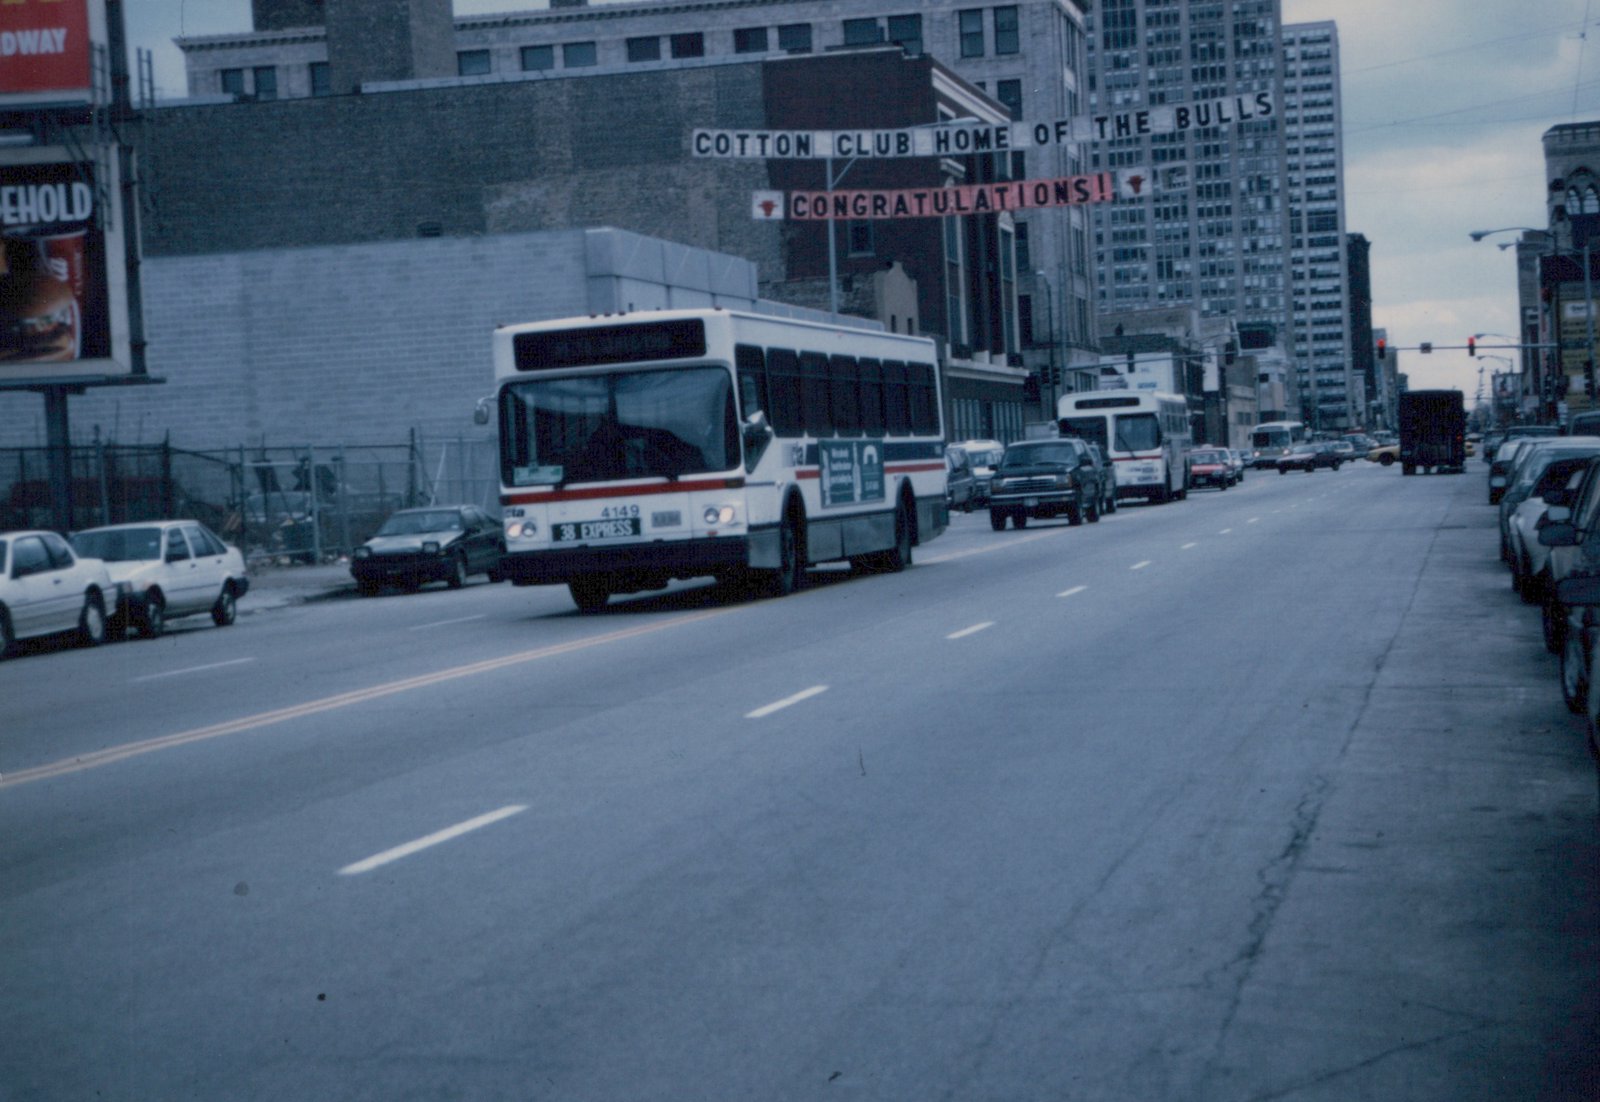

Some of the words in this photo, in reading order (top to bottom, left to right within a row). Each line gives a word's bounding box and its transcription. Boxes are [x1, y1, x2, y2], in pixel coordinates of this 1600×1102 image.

[0, 28, 67, 56] DWAY
[695, 132, 811, 155] COTTON
[837, 134, 909, 155] CLUB
[936, 127, 1008, 150] HOME
[1034, 120, 1068, 145] OF
[1095, 111, 1149, 139] THE
[1176, 92, 1272, 129] BULLS
[0, 182, 93, 223] EHOLD
[793, 173, 1105, 217] CONGRATULATIONS!
[601, 505, 640, 518] 4149
[561, 525, 576, 540] 38
[581, 521, 632, 538] EXPRESS
